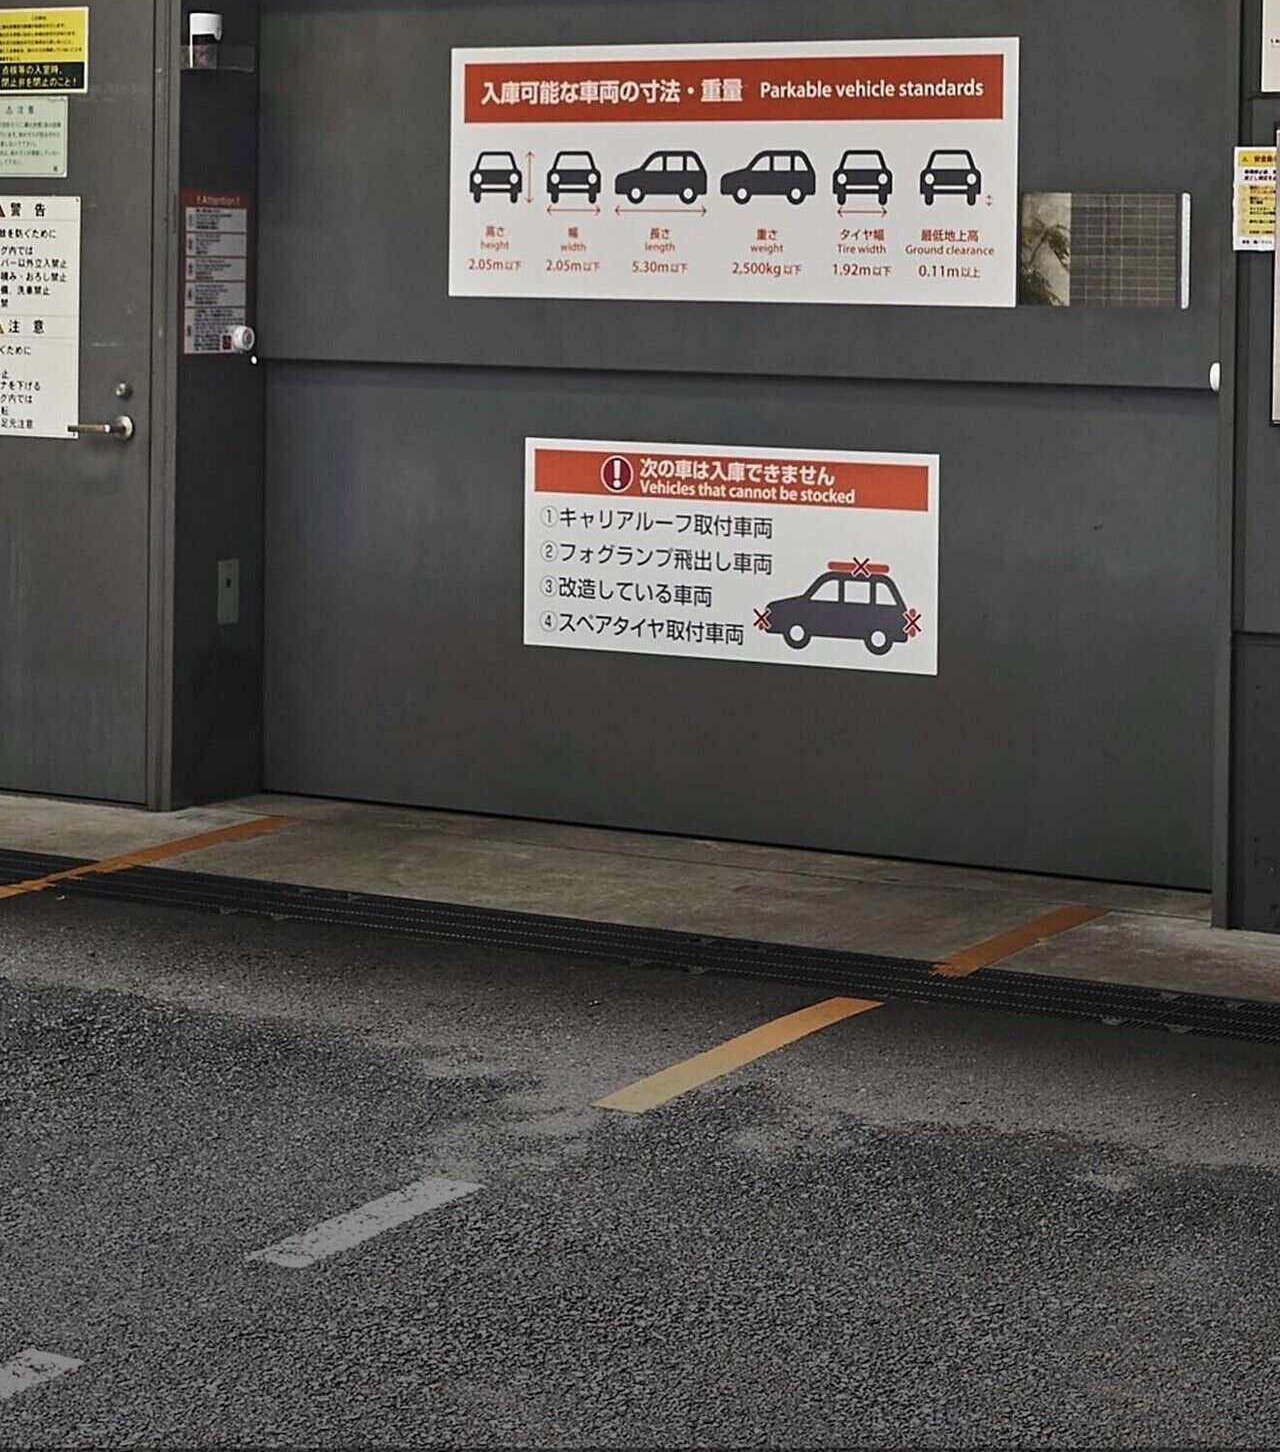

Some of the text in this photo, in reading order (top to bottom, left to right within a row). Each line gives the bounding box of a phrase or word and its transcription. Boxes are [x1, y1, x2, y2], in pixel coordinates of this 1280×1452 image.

[482, 76, 984, 106] 入庫可能な車両の寸法・重量 Parkable vehicle standards
[10, 203, 46, 218] 警告
[485, 225, 505, 238] 高さ
[567, 227, 579, 239] 幅
[649, 227, 671, 240] 長さ
[756, 228, 779, 241] 重さ
[839, 228, 885, 242] タイヤ幅
[920, 229, 980, 243] 最低地上高
[480, 240, 510, 252] height
[560, 241, 587, 253] width
[644, 241, 676, 255] length
[750, 242, 784, 256] weight
[837, 243, 887, 255] Tire width
[905, 244, 995, 257] Ground clearance
[468, 258, 523, 272] 2.05m以下
[545, 259, 600, 273] 2.05m以下
[631, 260, 689, 274] 5.30m以下
[832, 262, 892, 278] 1.92m以下
[918, 263, 981, 279] 0.11m以上
[8, 319, 46, 335] 注意
[640, 457, 835, 486] 次の車は入庫できません
[640, 479, 856, 505] Vehicles that cannot be stocked
